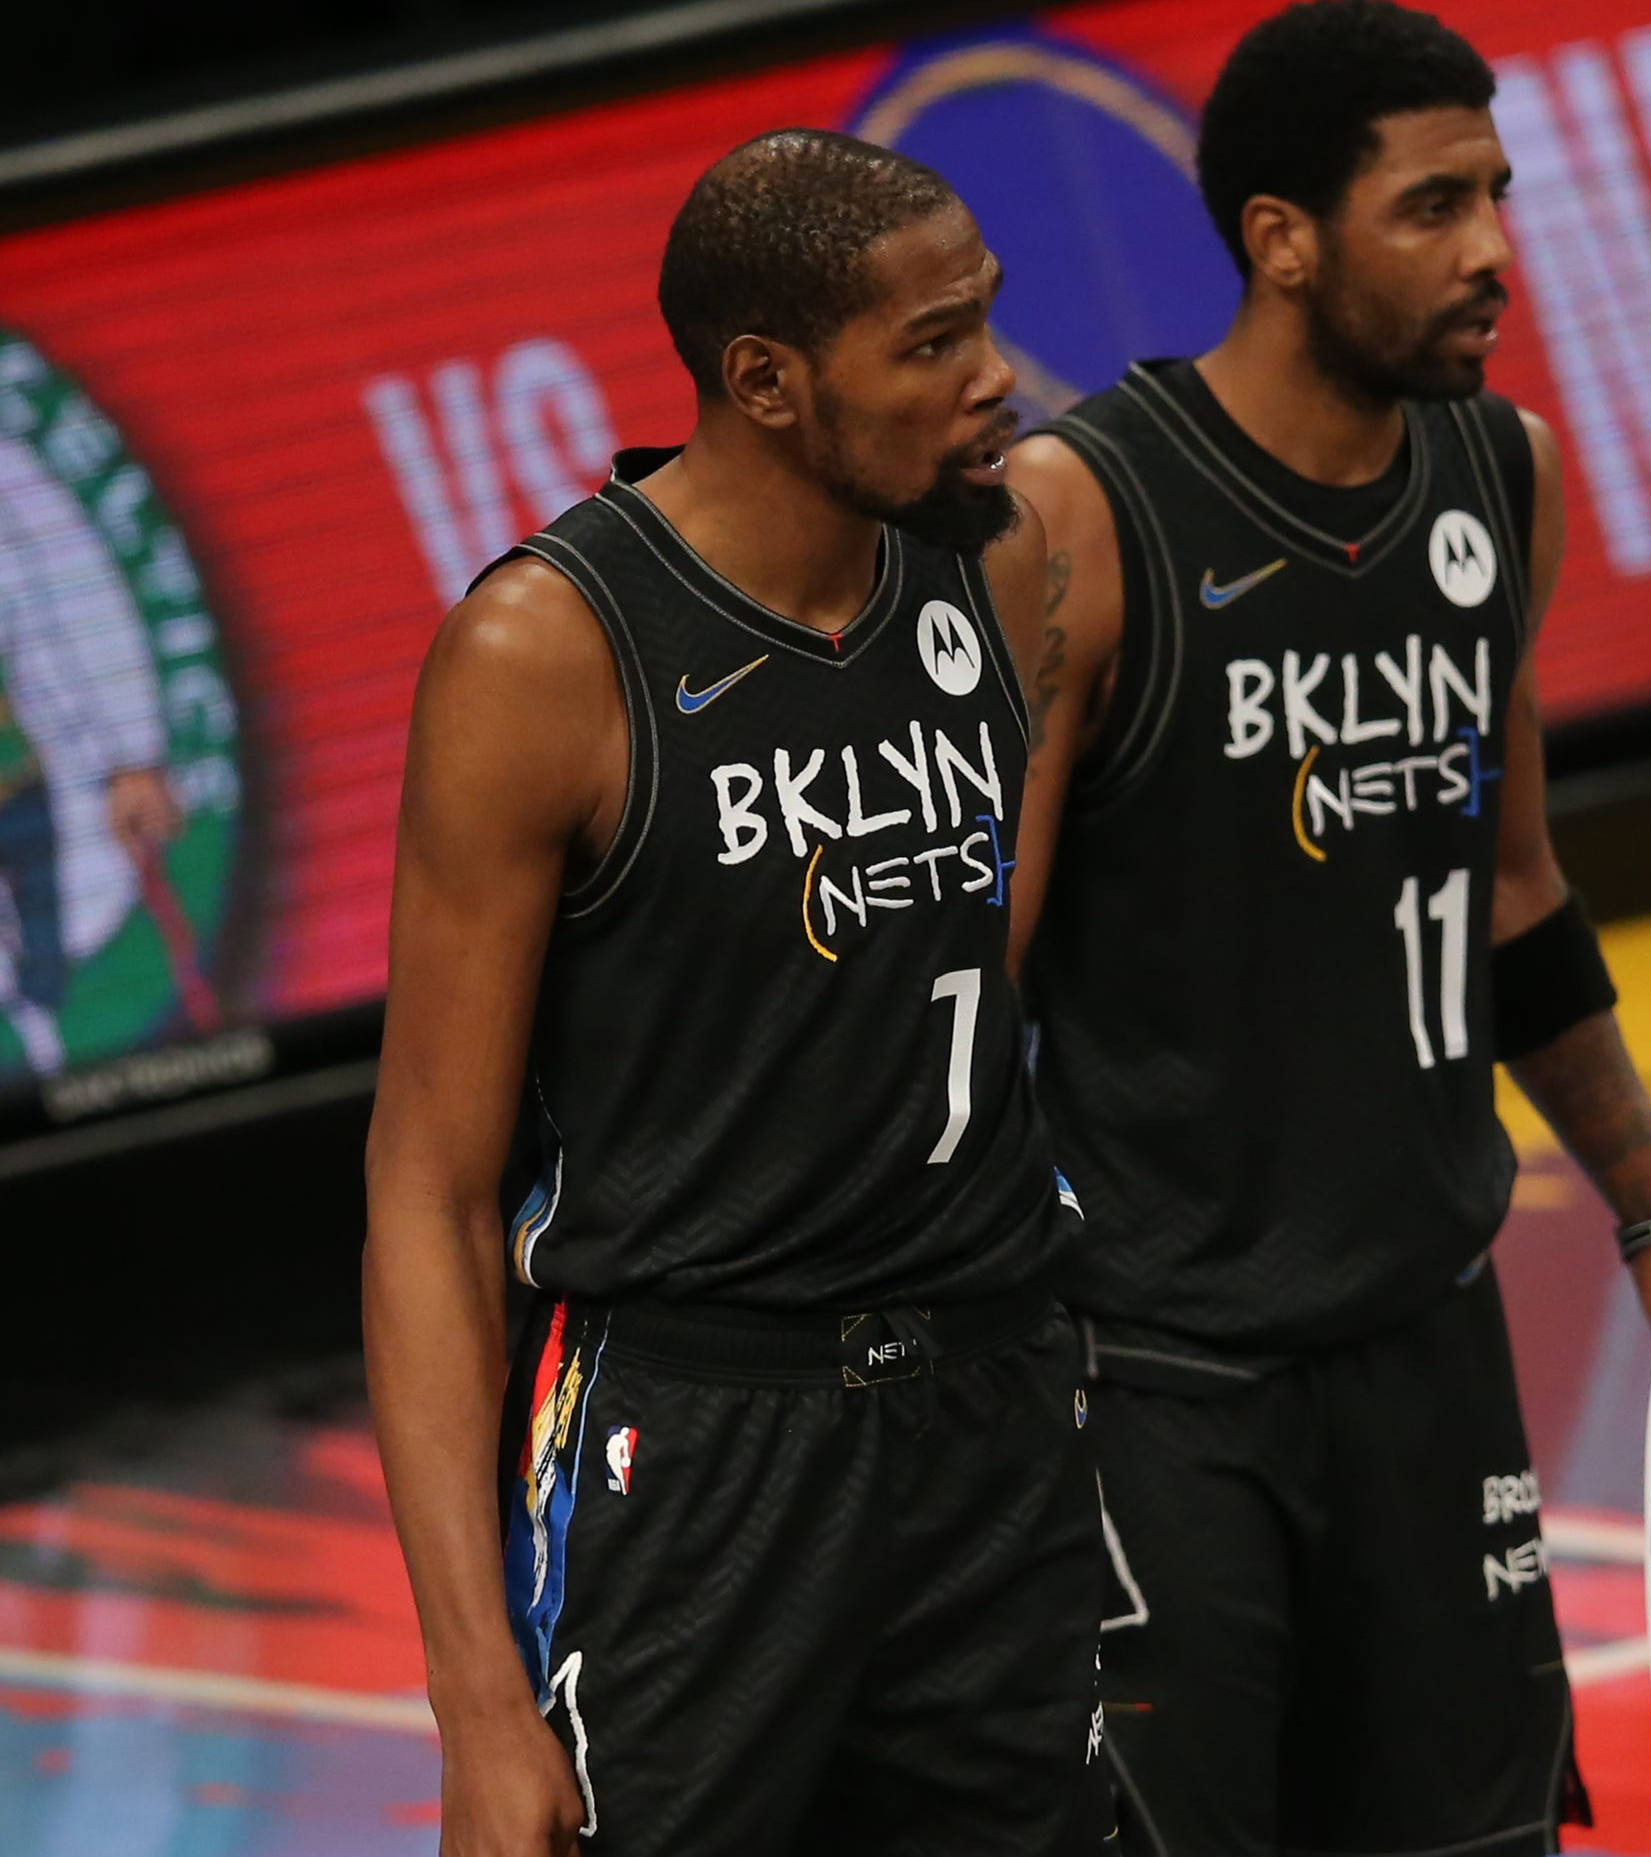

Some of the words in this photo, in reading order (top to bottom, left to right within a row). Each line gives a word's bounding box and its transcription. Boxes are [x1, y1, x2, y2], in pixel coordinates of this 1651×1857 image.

[1224, 634, 1491, 759] BKLYN
[710, 720, 1004, 866] BKLYN
[1394, 868, 1470, 1069] 11
